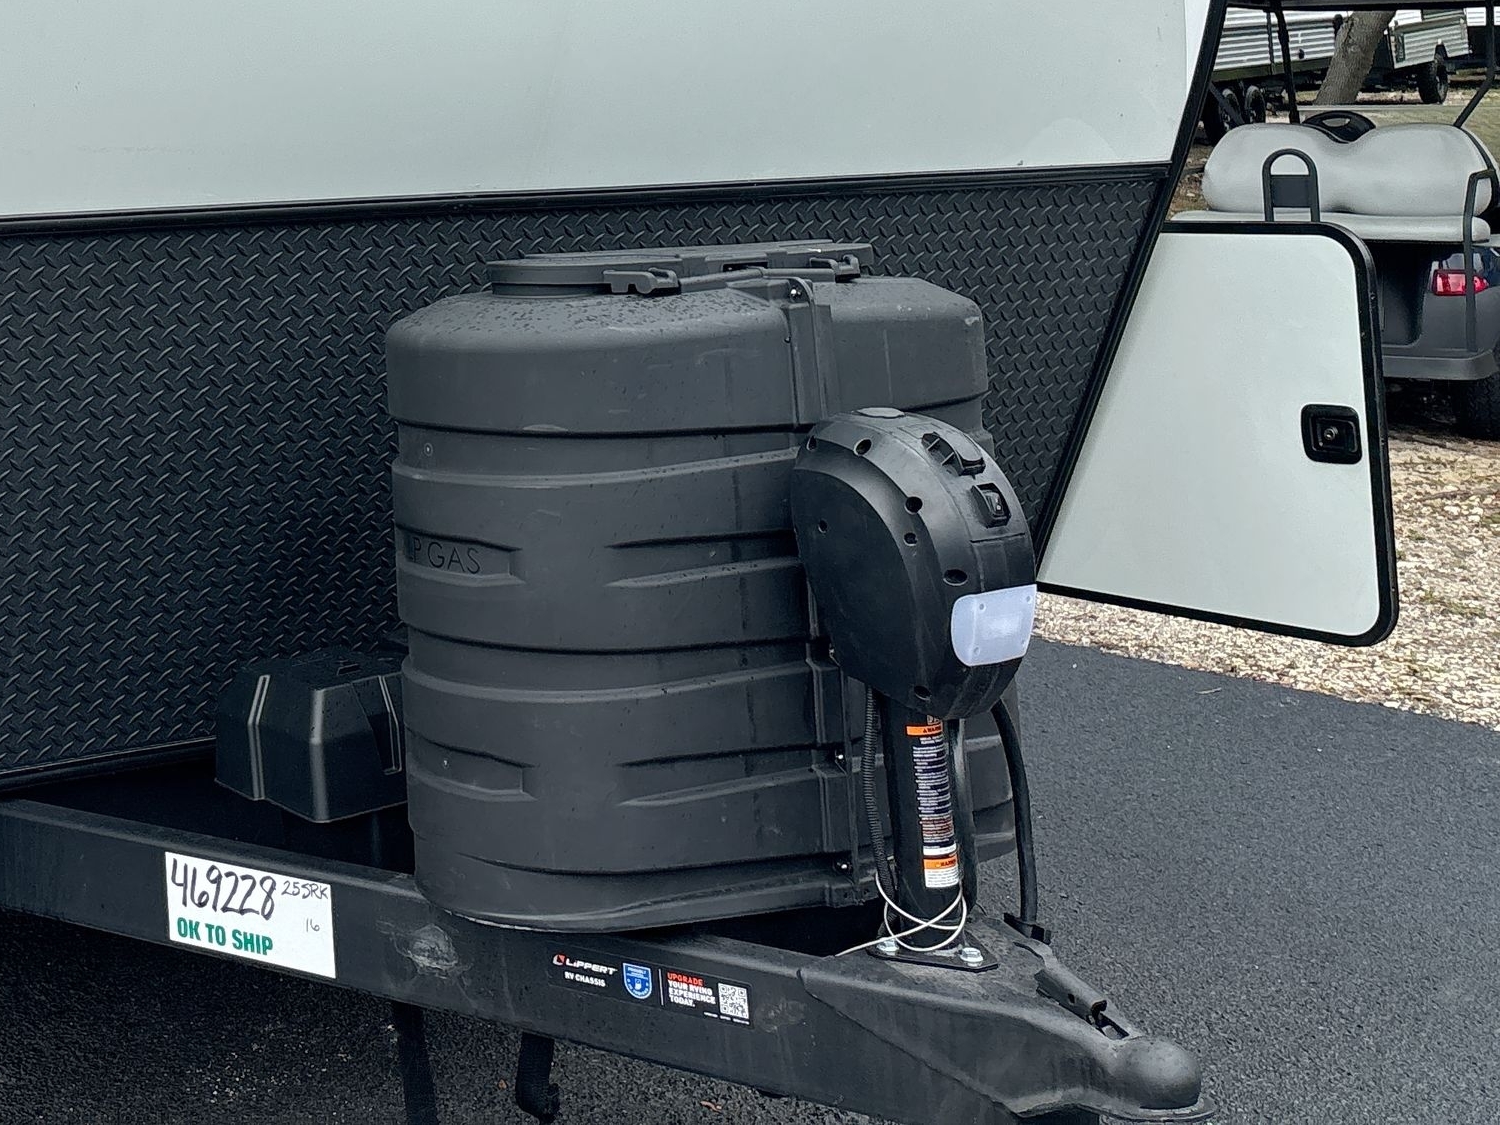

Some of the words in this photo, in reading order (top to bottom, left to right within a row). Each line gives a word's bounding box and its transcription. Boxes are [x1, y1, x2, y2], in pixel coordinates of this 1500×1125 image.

[427, 541, 481, 574] GAS
[171, 858, 276, 920] 469228
[305, 918, 320, 933] 16
[177, 917, 202, 941] OK
[205, 923, 226, 946] TO
[231, 929, 273, 955] SHIP
[565, 958, 618, 975] LIPPERT
[564, 971, 575, 980] RV
[575, 974, 606, 987] CHASSIS
[667, 972, 704, 986] UPGRADE
[668, 980, 688, 991] YOUR
[668, 987, 716, 1004] EXPERIENCE
